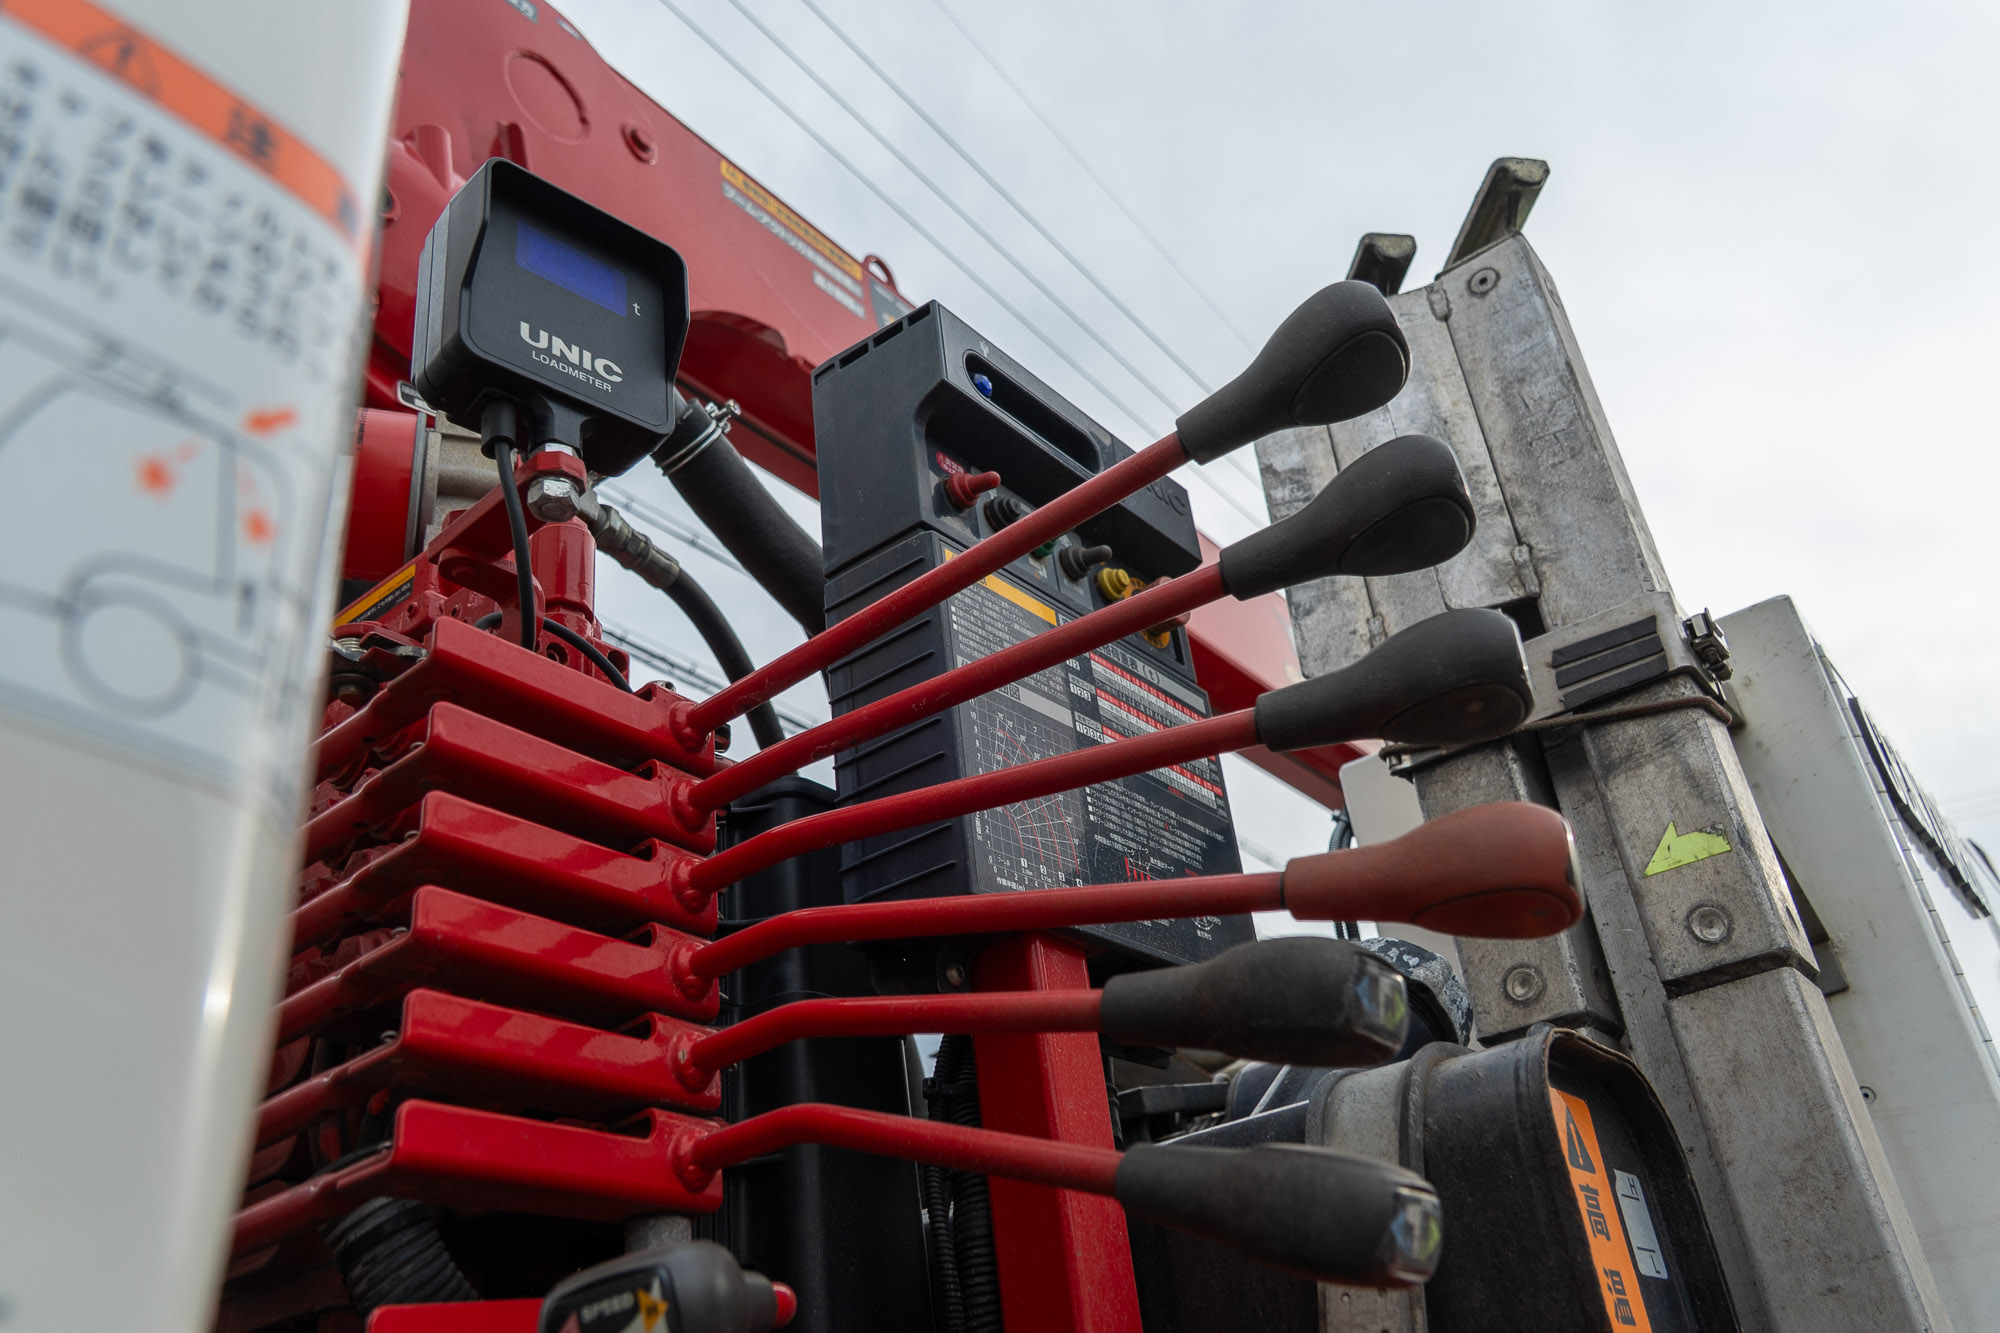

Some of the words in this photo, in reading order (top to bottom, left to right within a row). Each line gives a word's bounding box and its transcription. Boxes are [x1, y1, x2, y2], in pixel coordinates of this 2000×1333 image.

[520, 321, 623, 383] UNIC
[532, 350, 612, 393] LOADMETER
[1627, 1176, 1639, 1197] H
[1579, 1183, 1637, 1327] 高温
